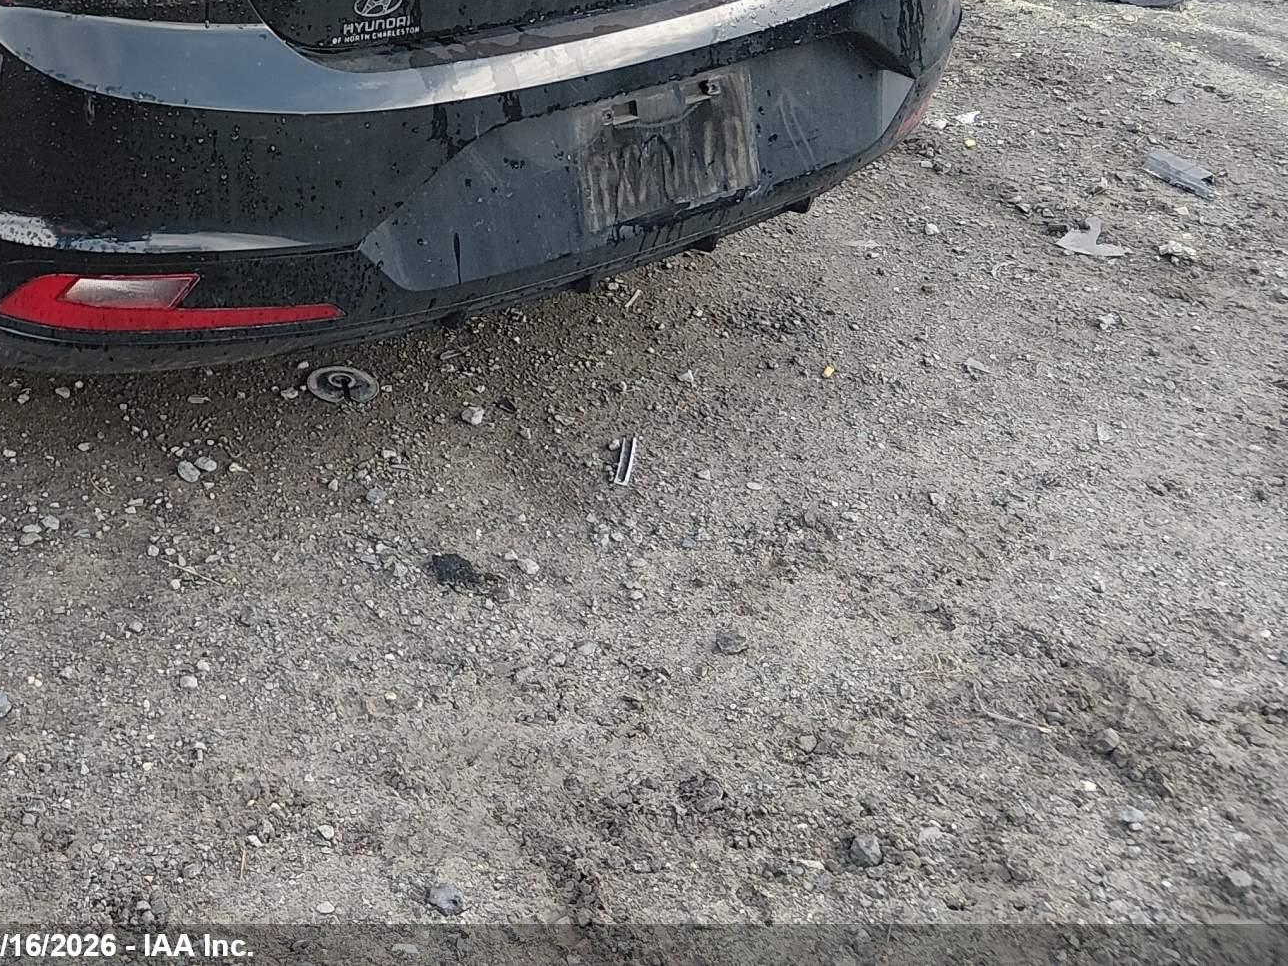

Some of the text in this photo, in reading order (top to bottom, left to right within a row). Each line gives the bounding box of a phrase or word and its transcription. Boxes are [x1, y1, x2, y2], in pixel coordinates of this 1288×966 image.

[343, 15, 411, 35] HYUNDAI
[332, 26, 420, 45] OF NORTH CHARLESTON
